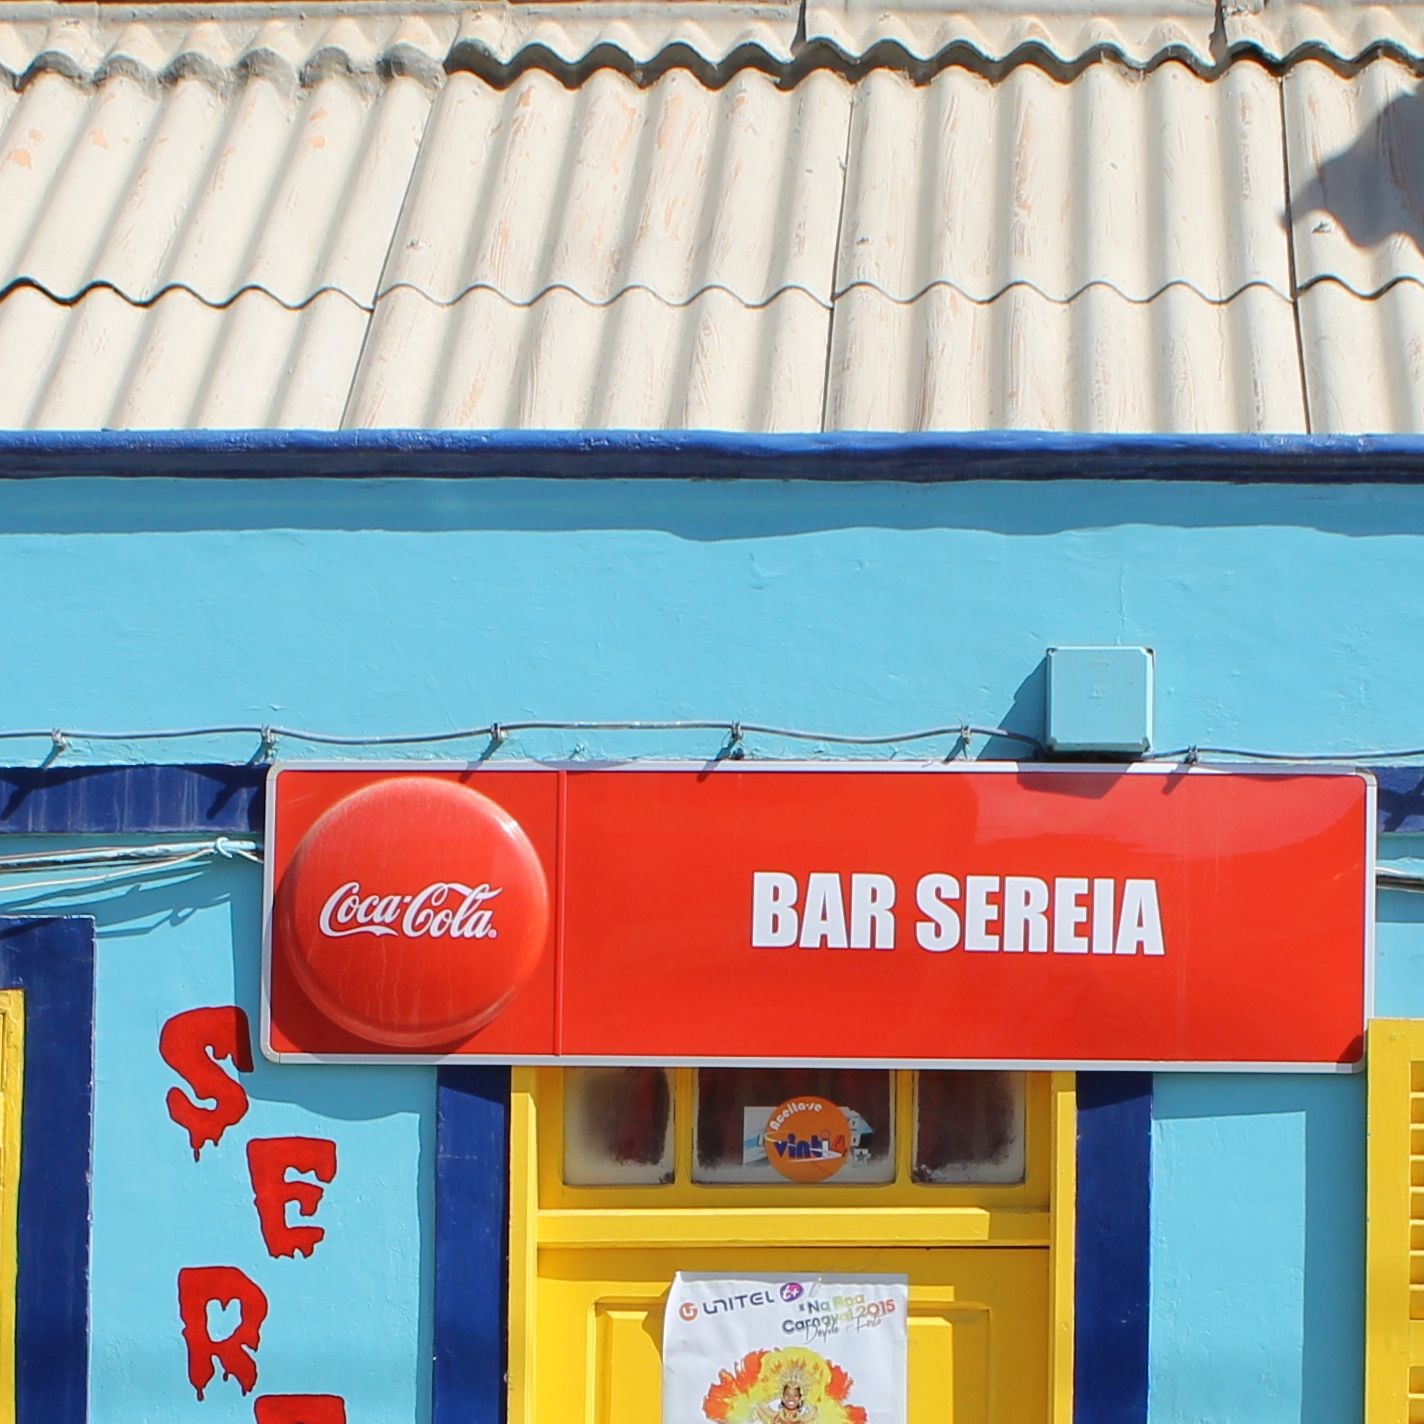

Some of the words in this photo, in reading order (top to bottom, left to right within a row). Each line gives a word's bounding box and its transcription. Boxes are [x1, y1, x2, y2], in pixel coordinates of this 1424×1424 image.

[318, 880, 503, 938] Coca-Cola
[751, 871, 897, 950] BAR
[915, 872, 1166, 957] SEREIA
[702, 1290, 775, 1315] UNITEL
[855, 1299, 896, 1318] 2015
